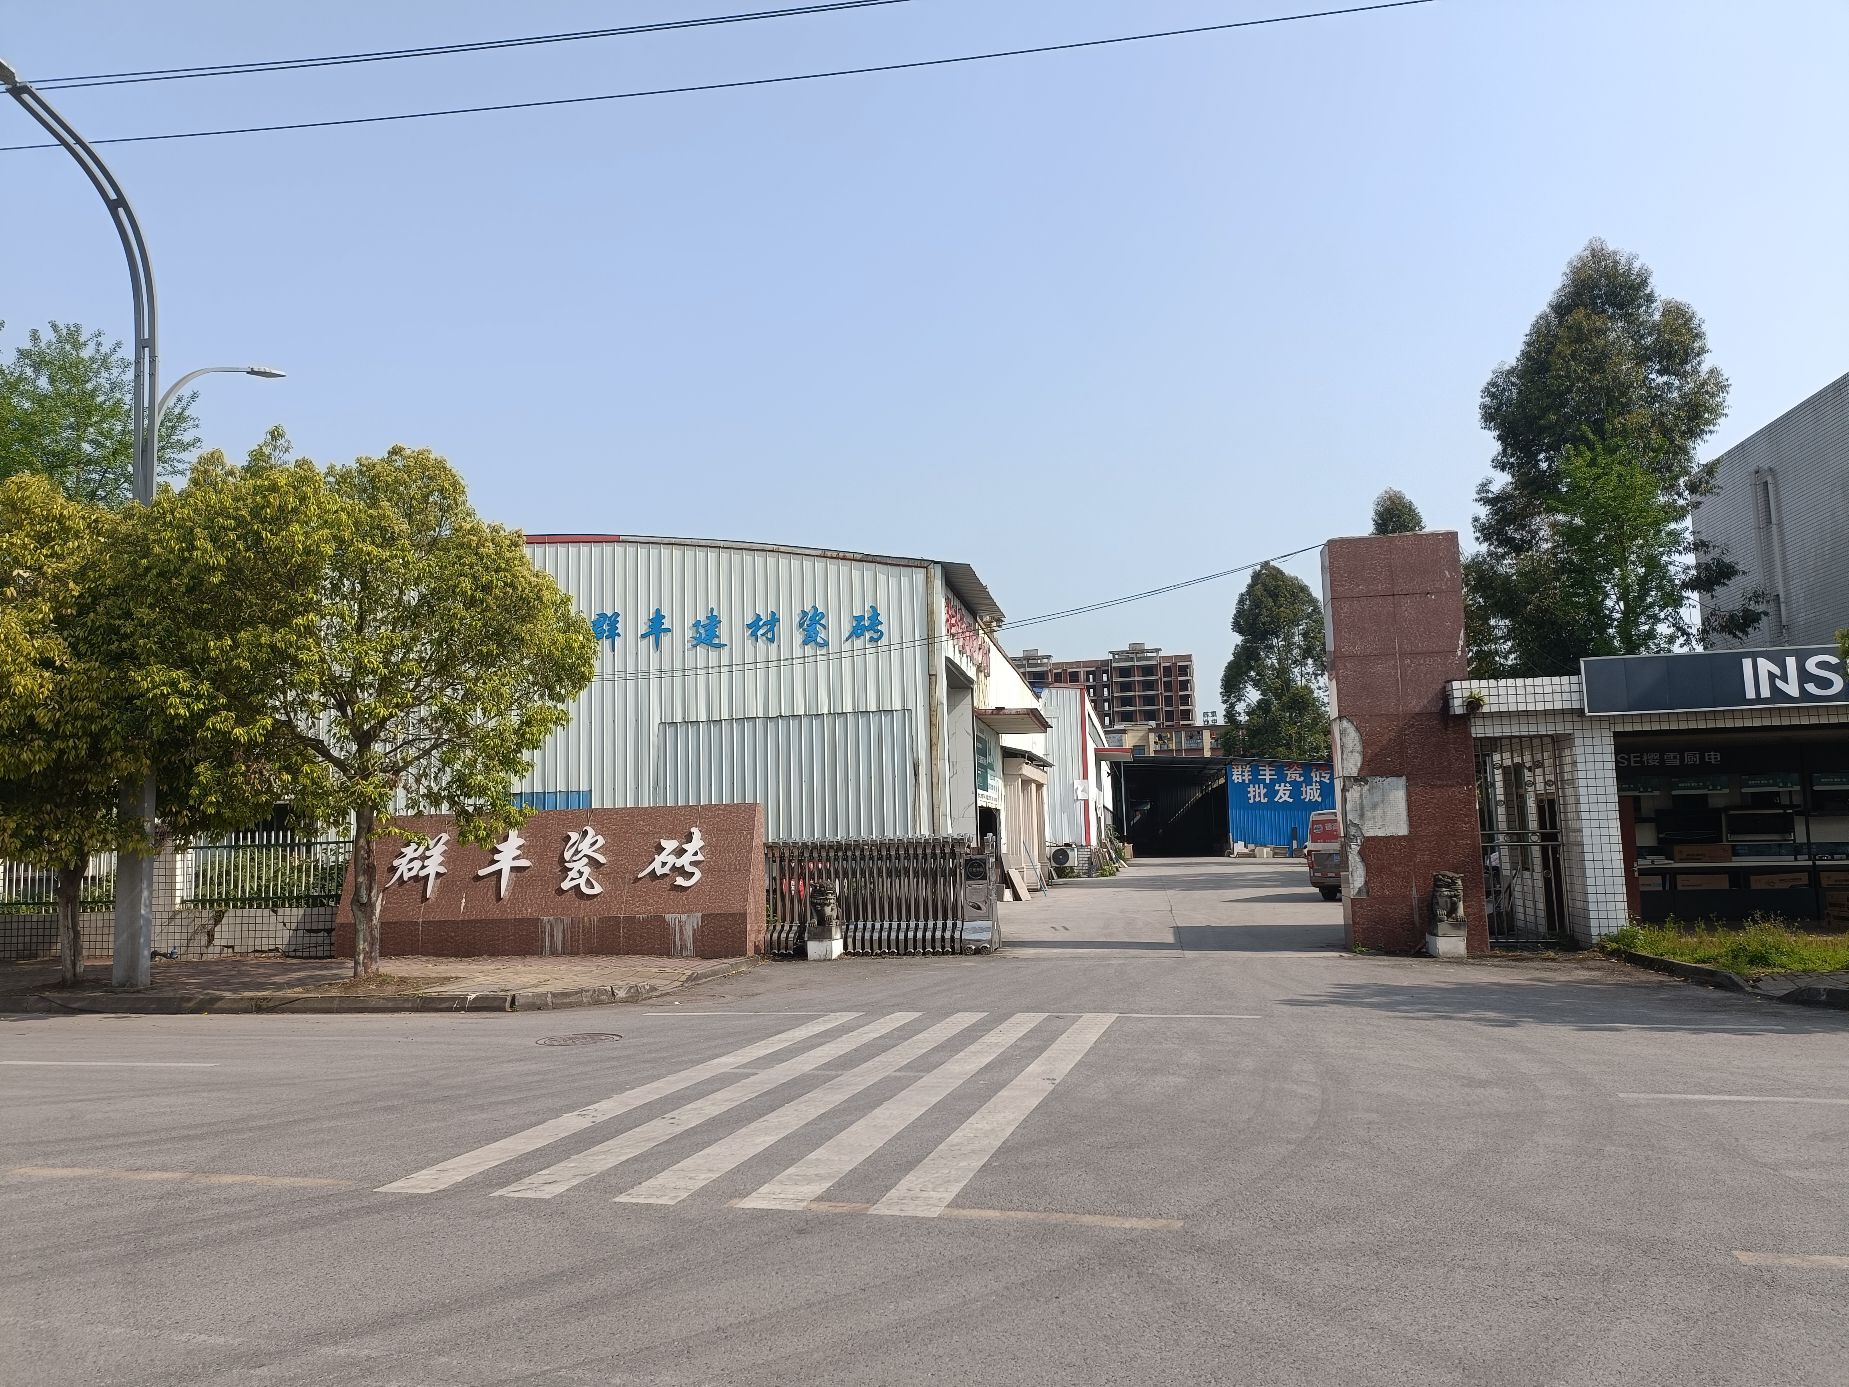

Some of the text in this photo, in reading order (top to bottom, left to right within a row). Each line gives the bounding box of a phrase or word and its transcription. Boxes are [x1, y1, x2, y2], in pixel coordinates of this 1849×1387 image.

[591, 605, 884, 652] 群丰建材瓷砖
[1232, 762, 1331, 783] 群丰瓷砖
[1247, 783, 1322, 804] 批发城
[385, 826, 705, 899] 群丰瓷砖
